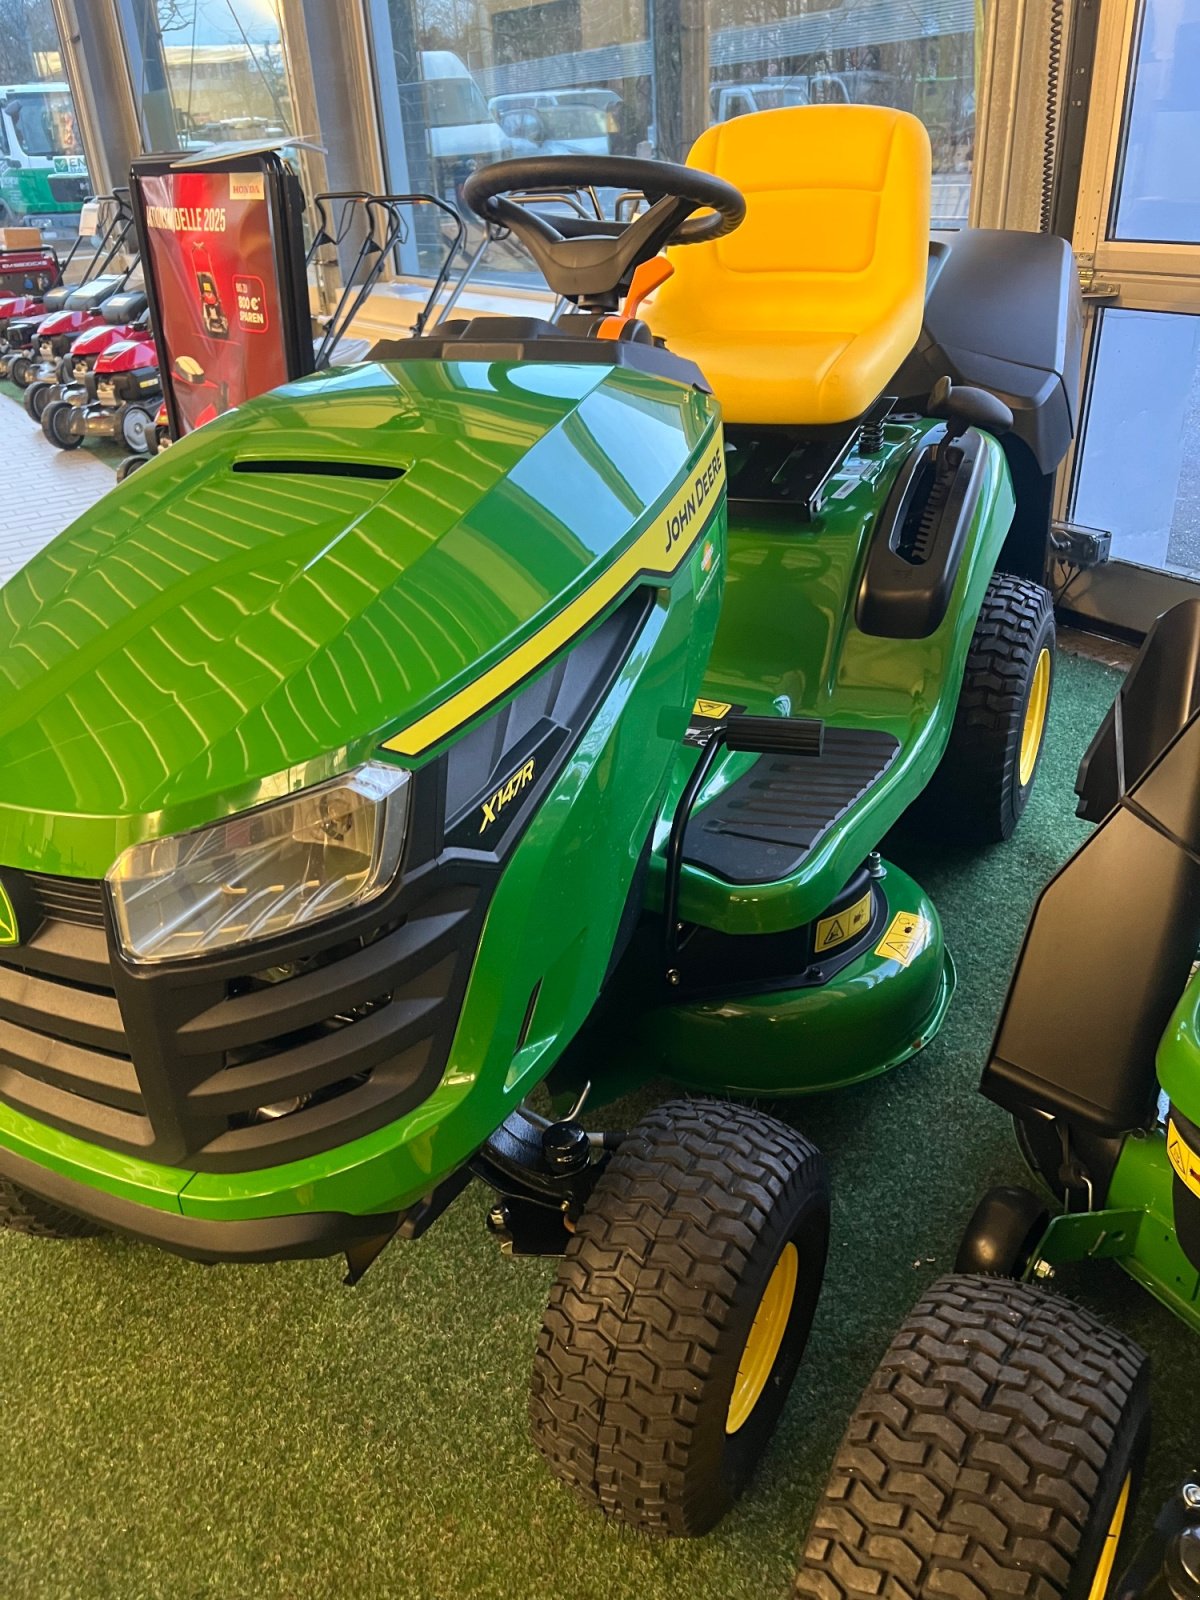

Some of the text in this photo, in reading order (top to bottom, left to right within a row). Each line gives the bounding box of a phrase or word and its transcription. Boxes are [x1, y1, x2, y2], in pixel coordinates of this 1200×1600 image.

[233, 184, 260, 195] HONDA
[203, 207, 226, 233] 2025
[239, 310, 264, 324] SPAREN
[665, 493, 697, 553] JOHN
[695, 447, 723, 508] DEERE
[479, 759, 535, 834] X147R
